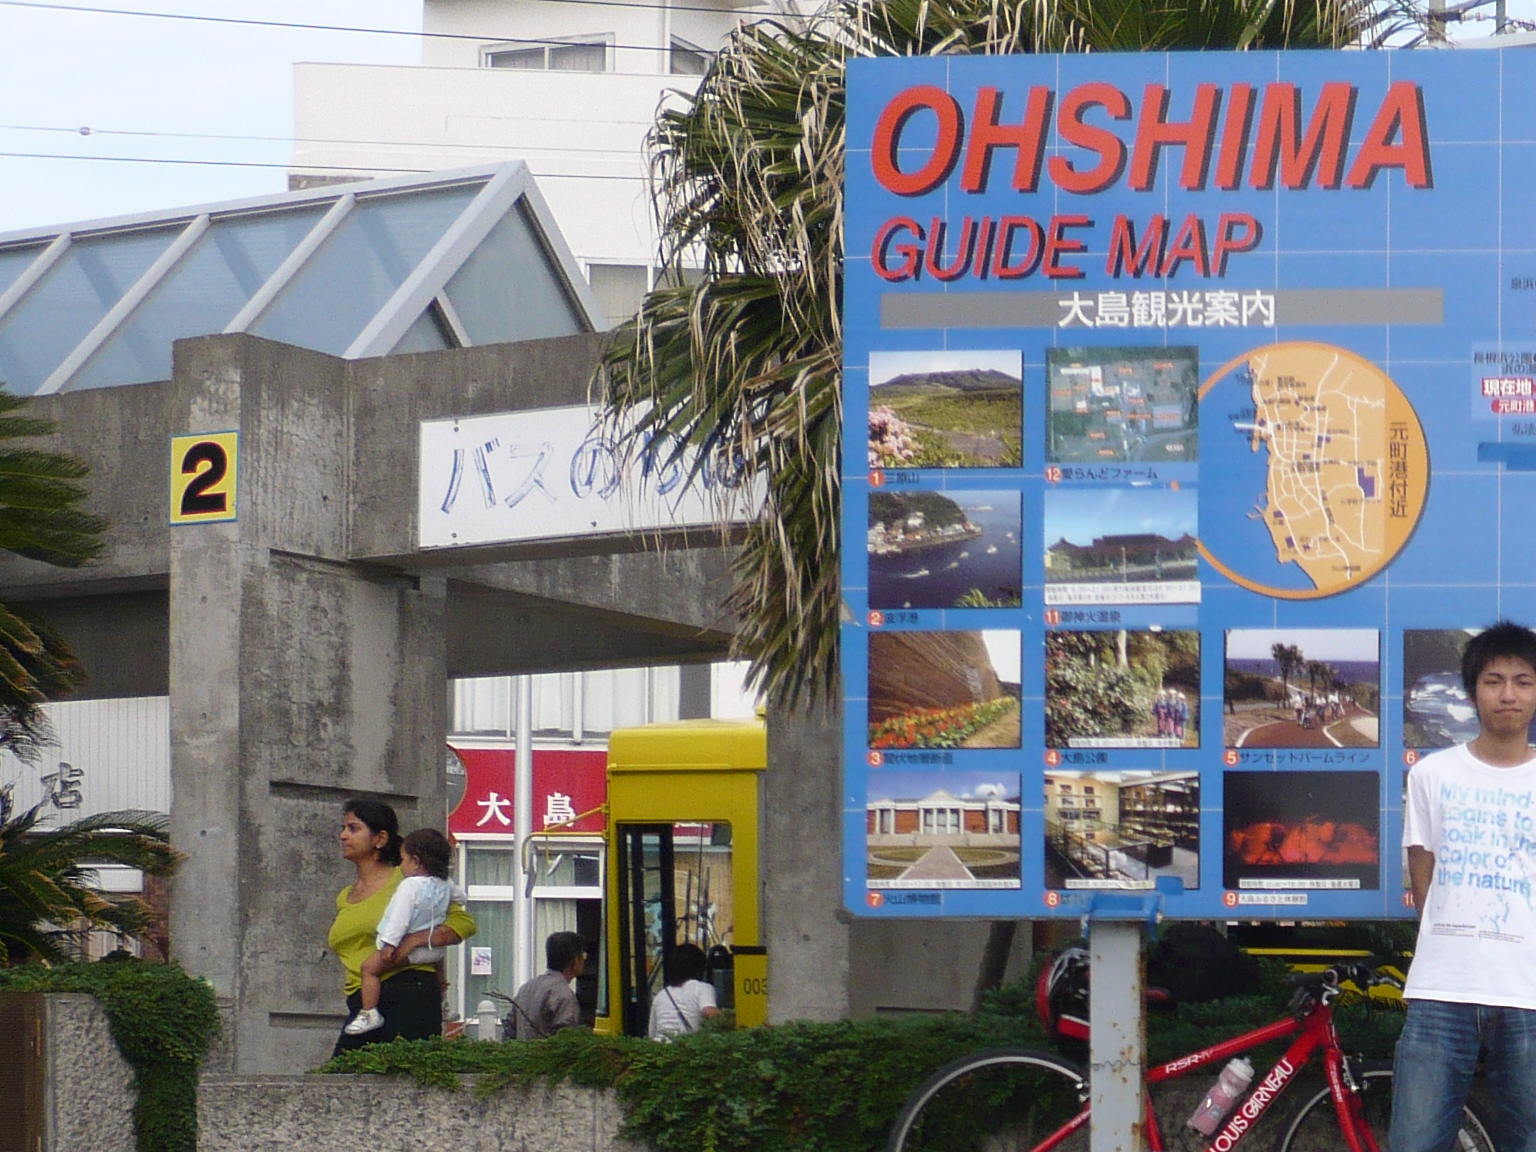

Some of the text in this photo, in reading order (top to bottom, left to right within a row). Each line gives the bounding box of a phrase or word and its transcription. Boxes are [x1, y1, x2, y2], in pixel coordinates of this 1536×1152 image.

[870, 81, 1433, 196] OHSHIMA
[871, 212, 1262, 282] GUIDE MAP
[1057, 290, 1276, 327] 大島観光案内
[1483, 378, 1532, 396] 現在地
[1498, 399, 1535, 413] 元町港
[180, 441, 227, 516] 2
[1389, 421, 1409, 519] 元町港付近
[1476, 788, 1532, 809] mind
[1514, 811, 1534, 832] to
[1491, 831, 1508, 849] in
[1438, 868, 1464, 887] the
[1242, 1057, 1294, 1119] GARNEAU
